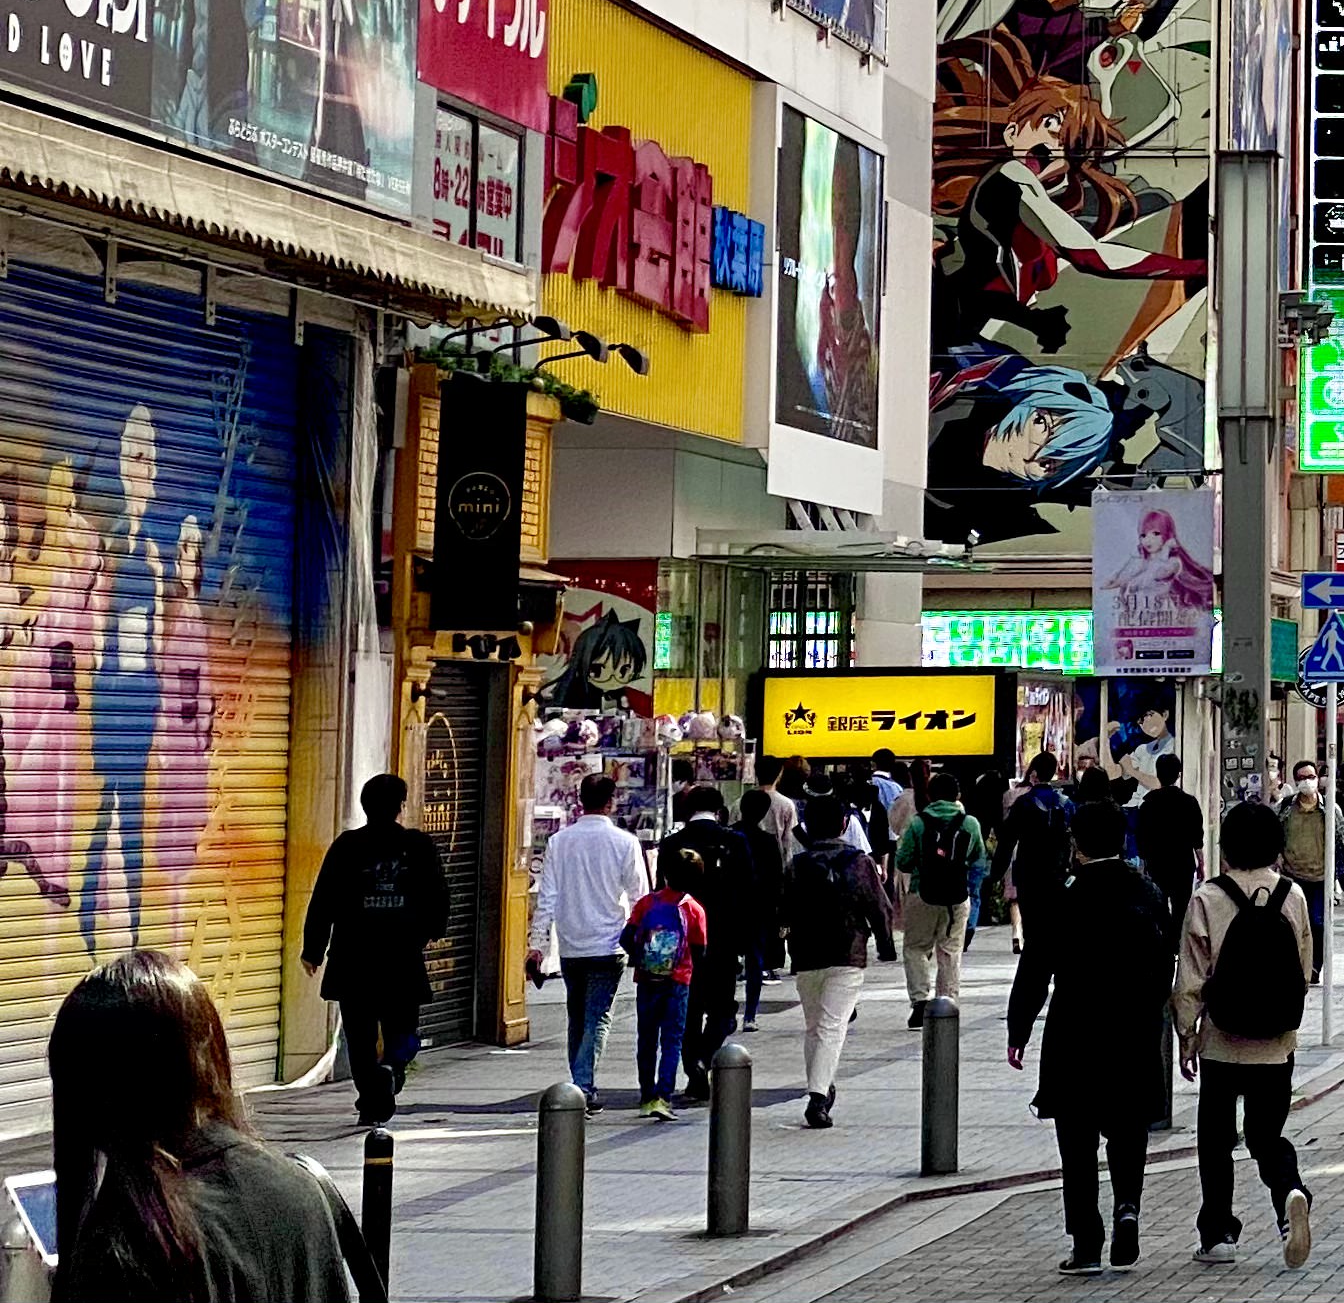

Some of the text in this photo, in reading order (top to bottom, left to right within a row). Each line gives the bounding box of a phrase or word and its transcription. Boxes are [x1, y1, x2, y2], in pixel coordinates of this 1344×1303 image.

[41, 24, 112, 87] LOVE
[458, 497, 501, 515] mini
[827, 709, 977, 732] 銀座ライオン
